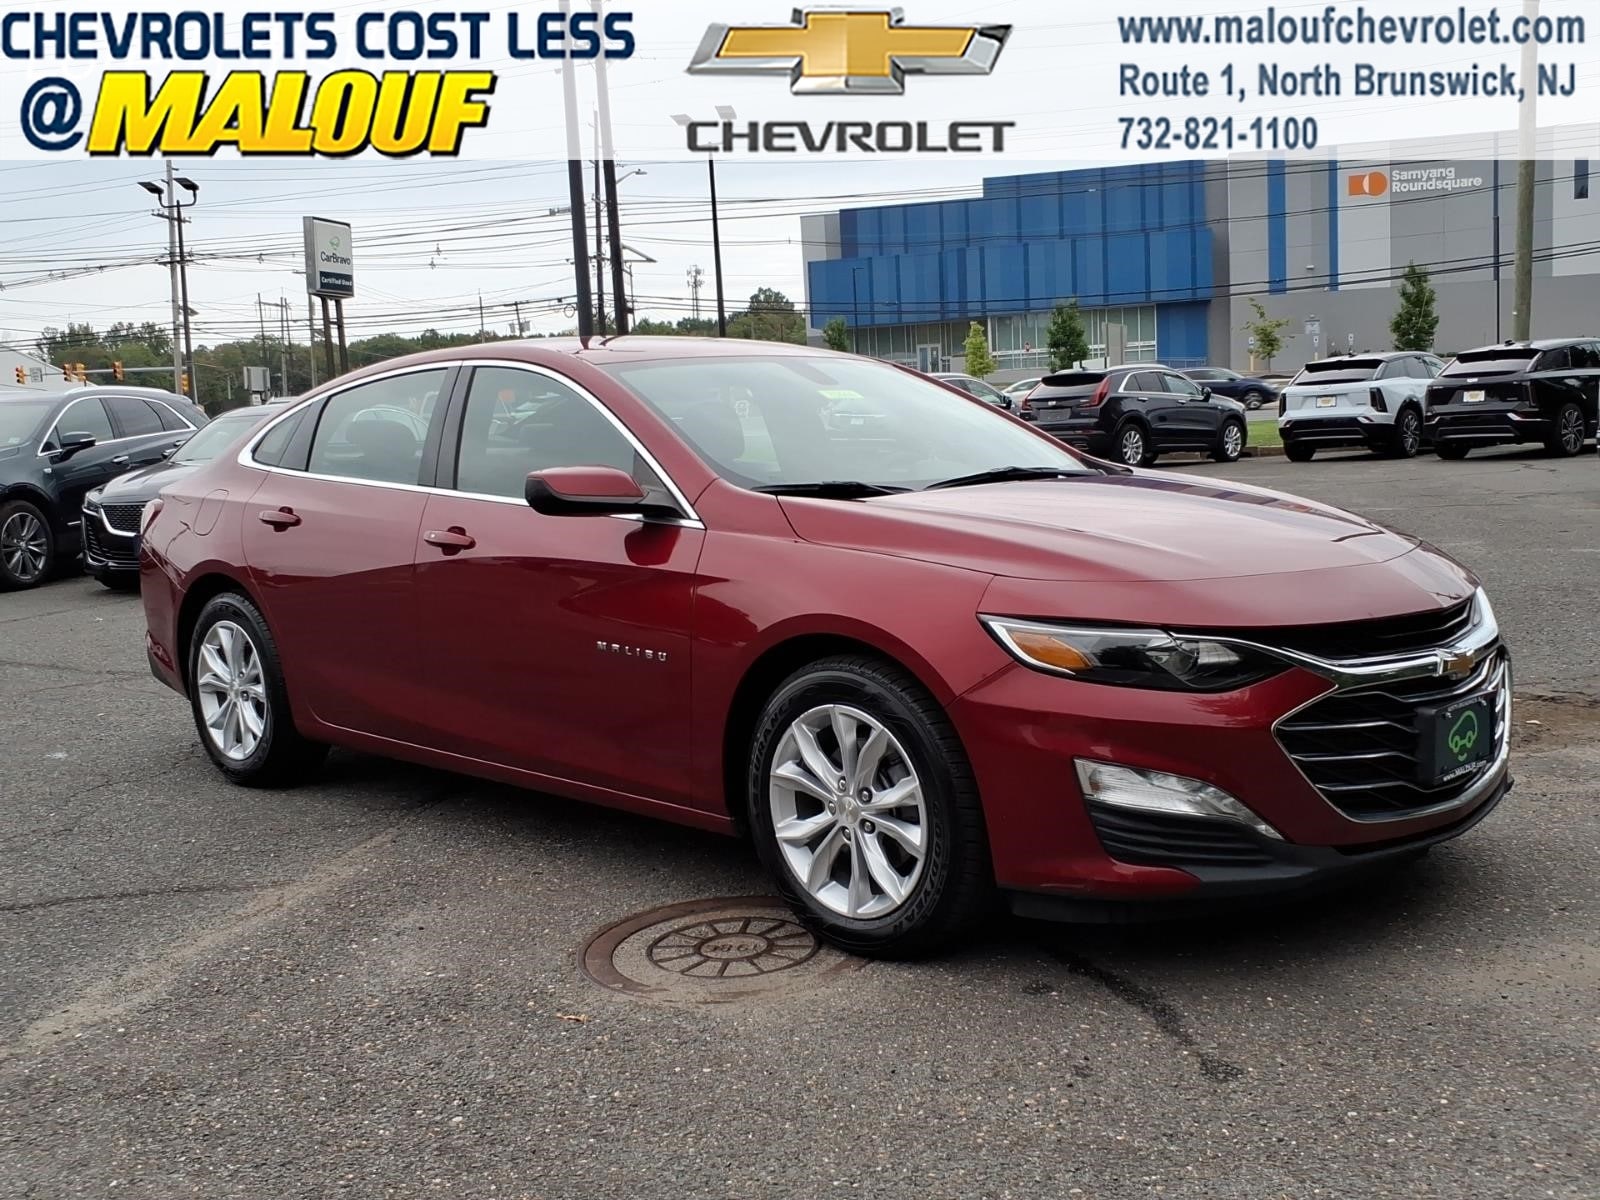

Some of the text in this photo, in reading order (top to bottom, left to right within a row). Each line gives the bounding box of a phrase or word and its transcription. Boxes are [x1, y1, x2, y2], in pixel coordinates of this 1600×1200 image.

[1392, 167, 1455, 180] Samyang
[1392, 176, 1482, 192] Roundsquare
[597, 641, 667, 661] MALIBU
